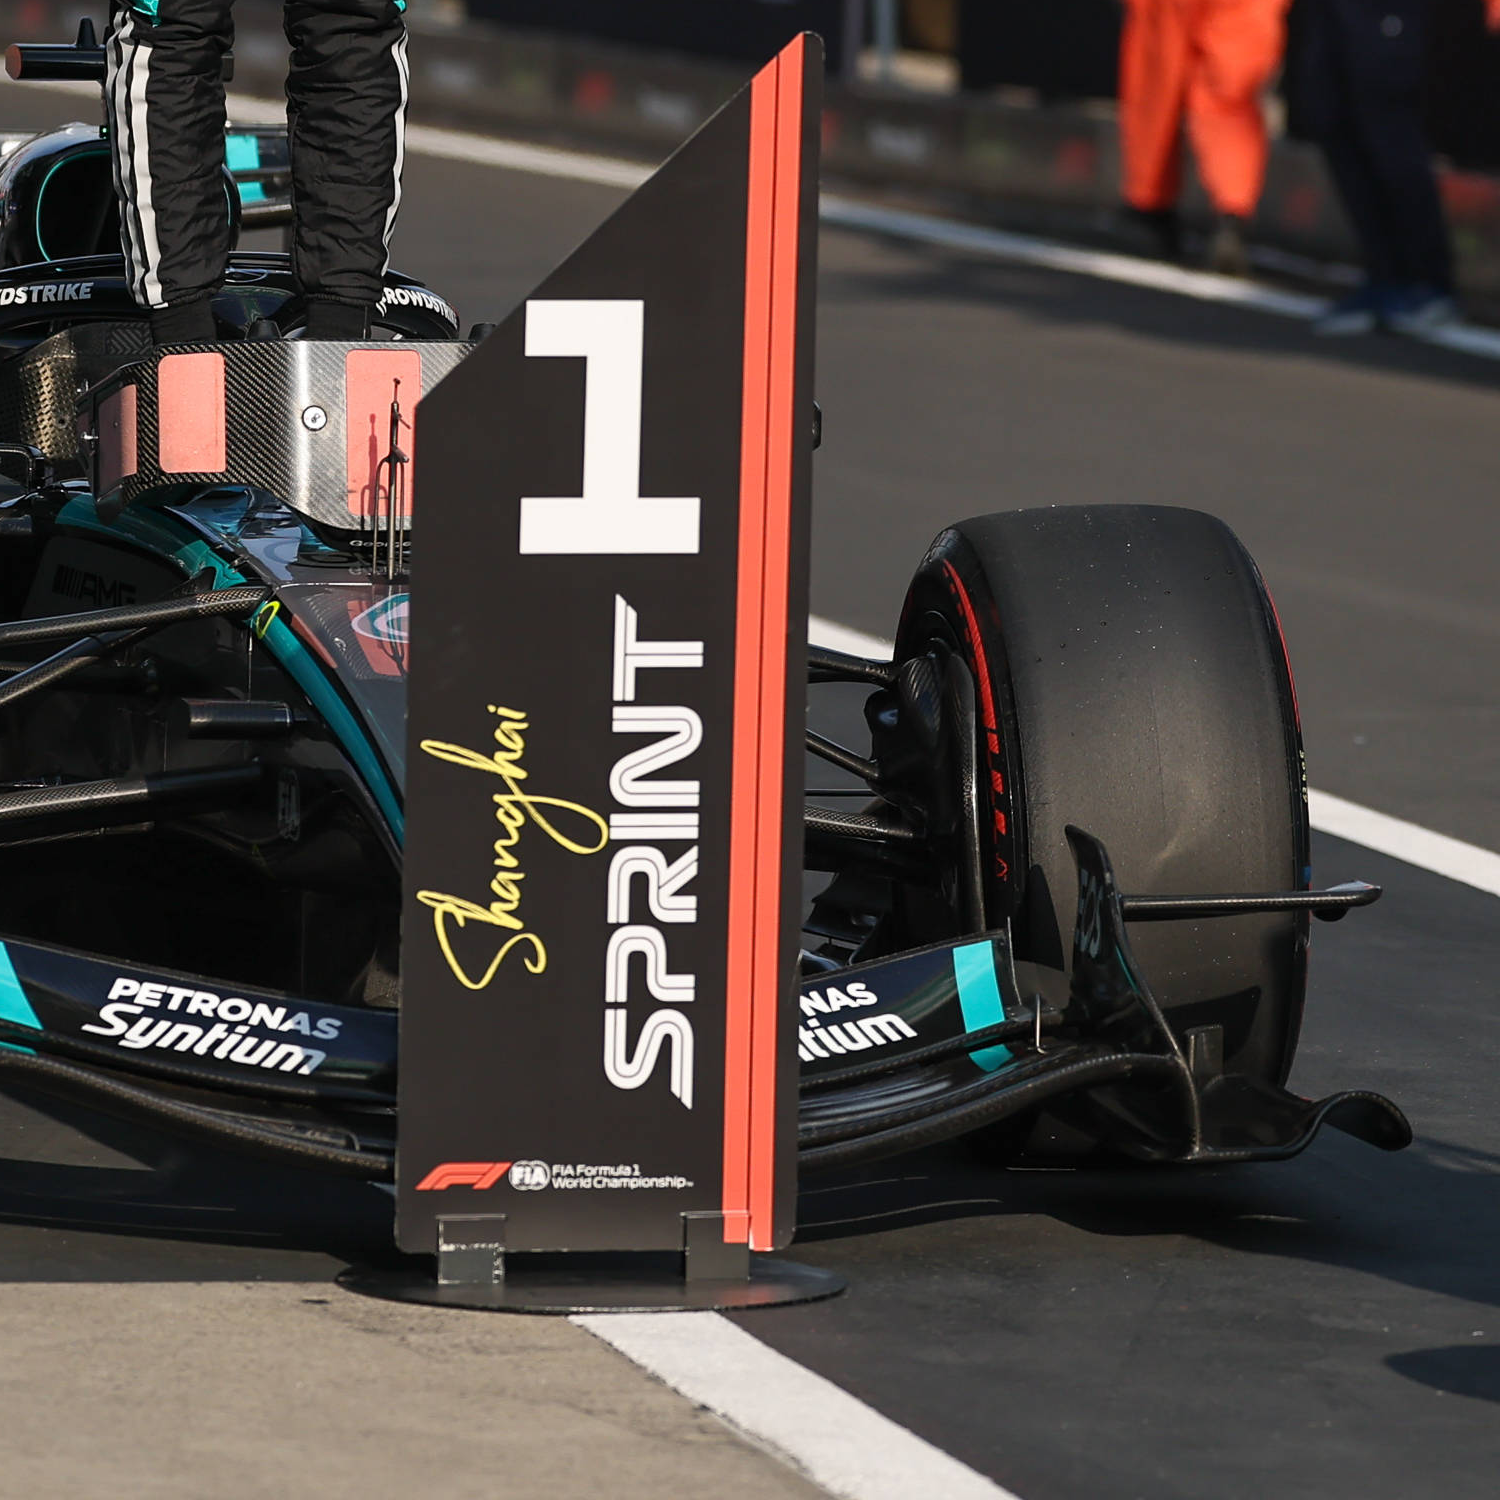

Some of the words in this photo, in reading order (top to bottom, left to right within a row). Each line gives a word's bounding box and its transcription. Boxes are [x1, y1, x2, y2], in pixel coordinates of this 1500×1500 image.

[519, 300, 700, 554] 1
[417, 703, 609, 990] Shanghai
[603, 593, 704, 1110] SPRINT
[82, 1003, 327, 1077] Syntium
[108, 976, 341, 1041] PETRONAS
[798, 1013, 919, 1062] tium
[511, 1164, 547, 1187] FIA
[552, 1164, 574, 1176] FIA
[576, 1164, 632, 1177] Formula
[633, 1164, 641, 1176] 1
[552, 1177, 591, 1189] World
